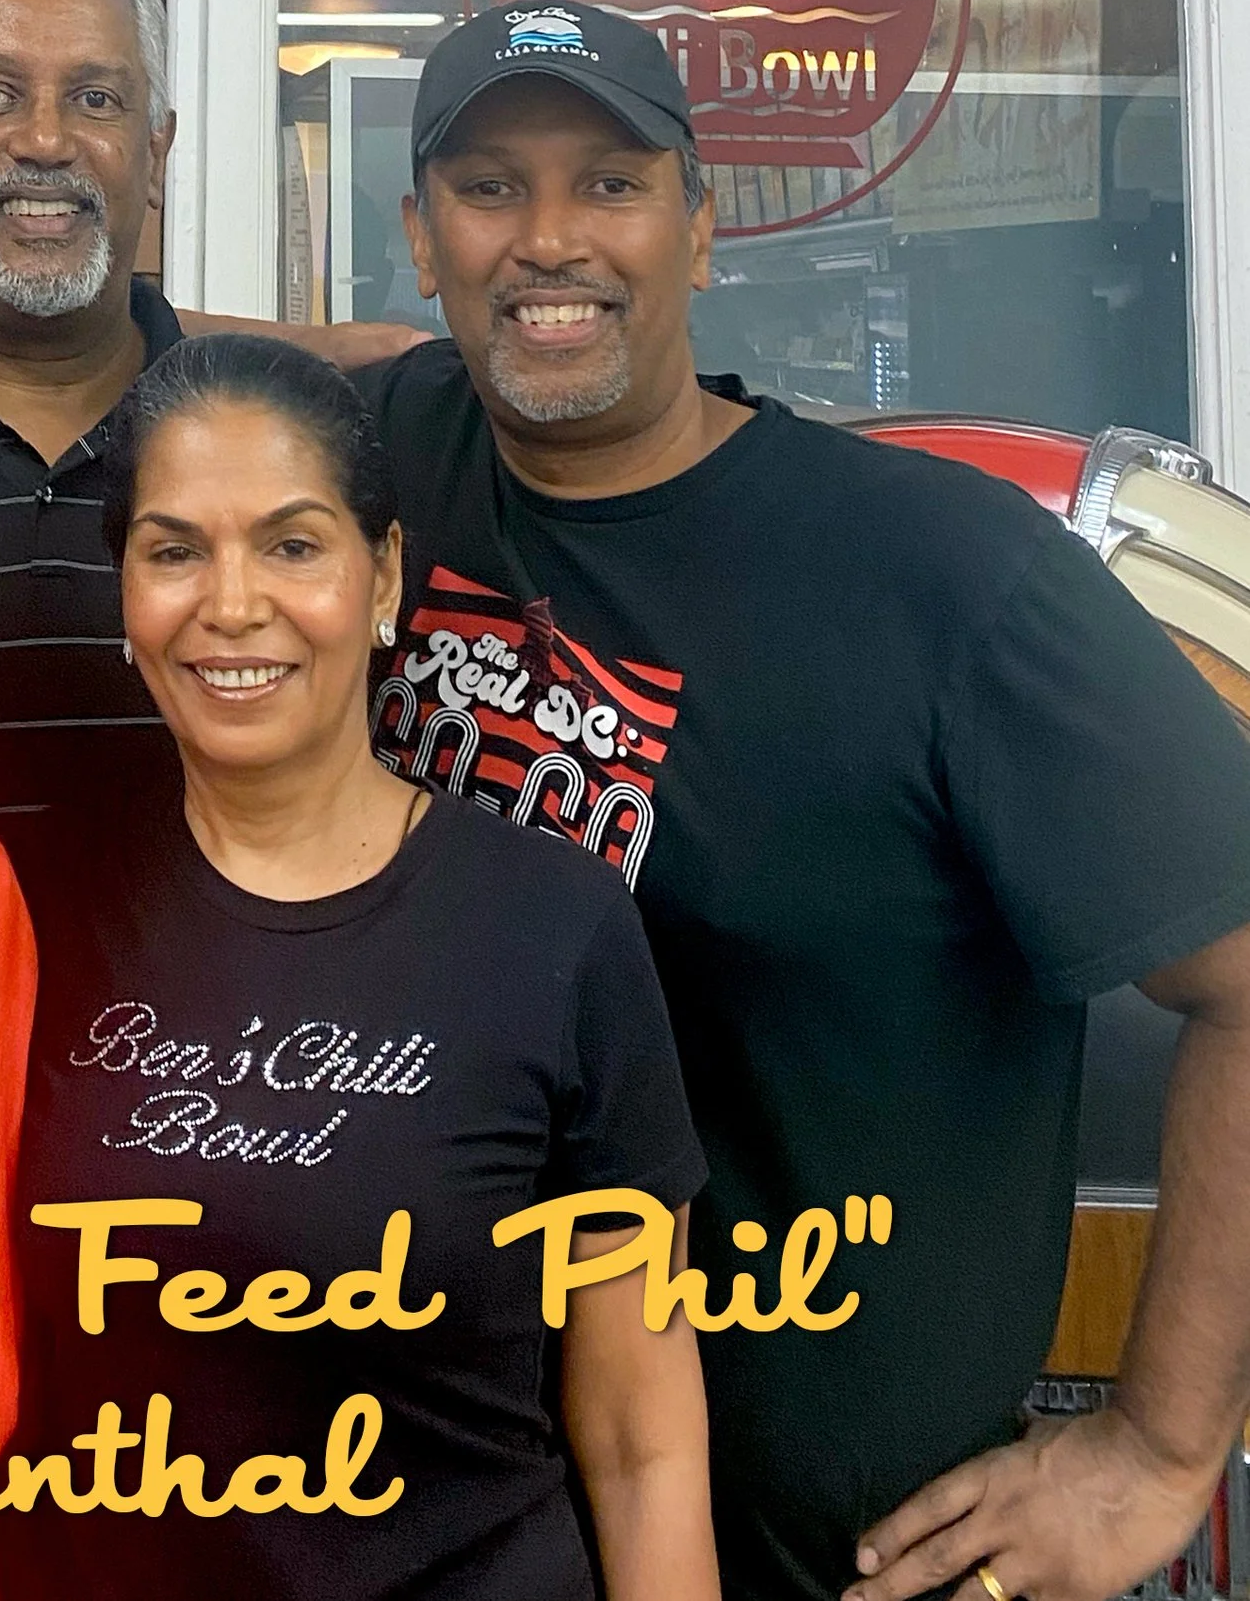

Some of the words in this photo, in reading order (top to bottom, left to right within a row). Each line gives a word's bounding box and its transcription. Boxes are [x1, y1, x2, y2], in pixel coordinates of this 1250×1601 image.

[495, 46, 531, 60] CASA
[719, 28, 877, 102] Bowl
[403, 629, 527, 715] Real
[472, 633, 520, 670] The
[69, 1001, 264, 1086] Ben's
[263, 1020, 437, 1096] Chili
[101, 1089, 349, 1168] Bowl
